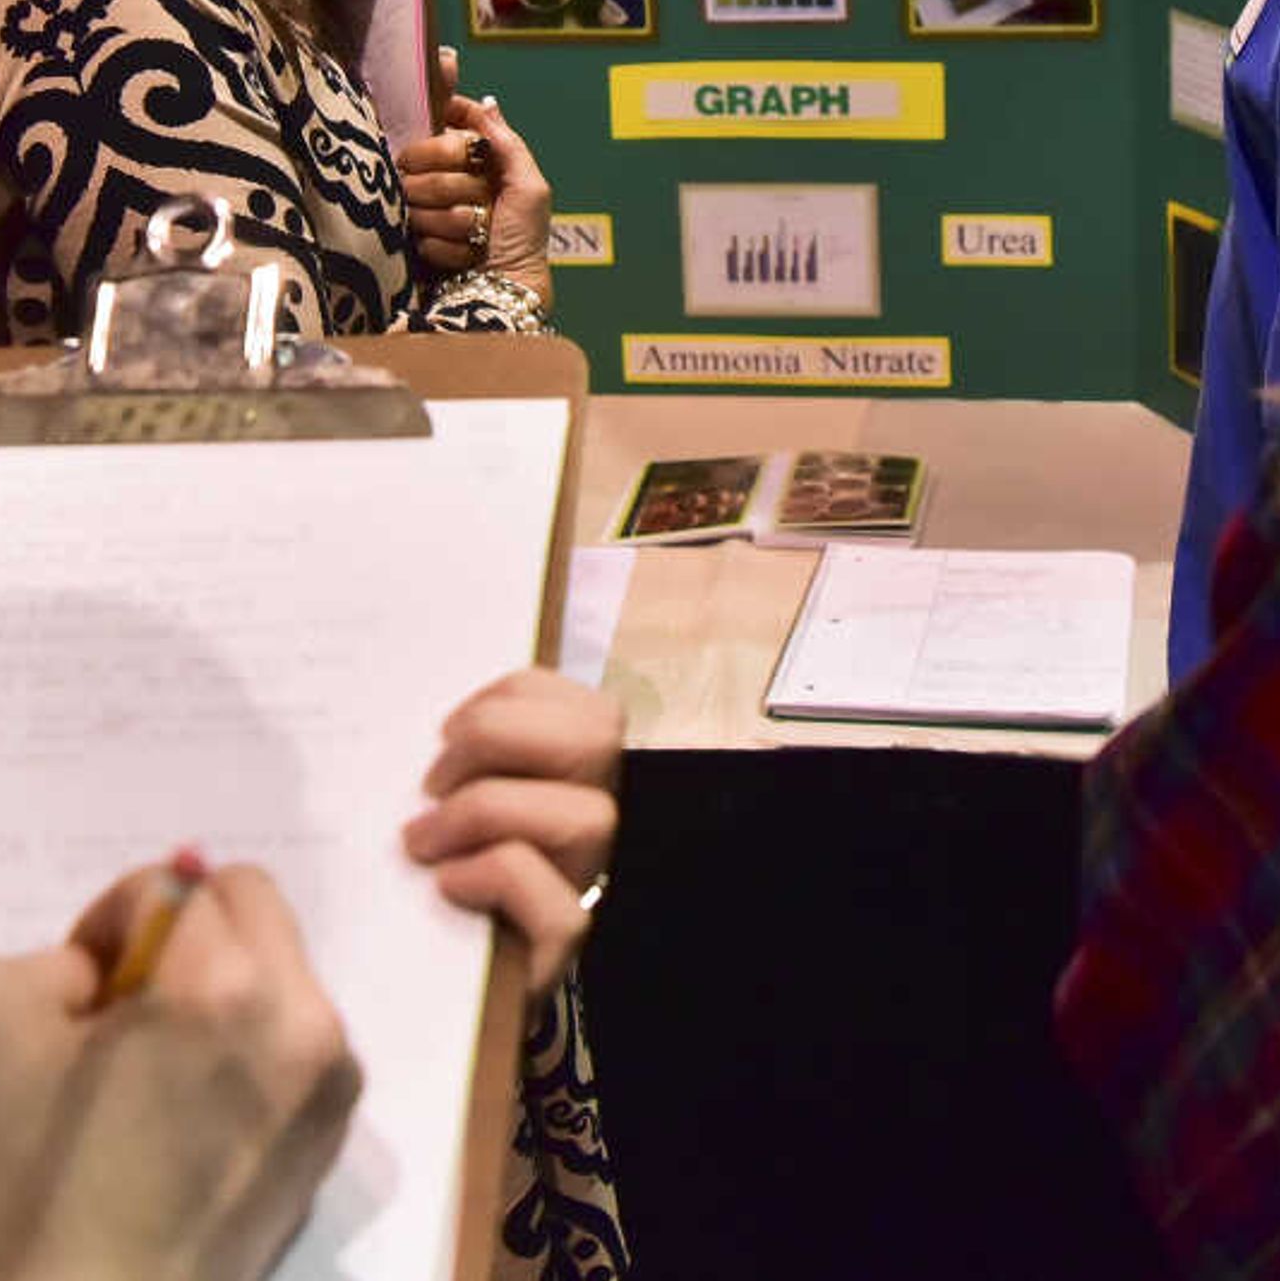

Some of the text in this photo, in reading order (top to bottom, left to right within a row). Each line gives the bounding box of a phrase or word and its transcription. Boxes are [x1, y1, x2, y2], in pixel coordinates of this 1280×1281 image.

[693, 83, 851, 118] GRAPH
[955, 222, 1037, 256] Urea
[640, 345, 937, 376] Ammonia Nitrate
